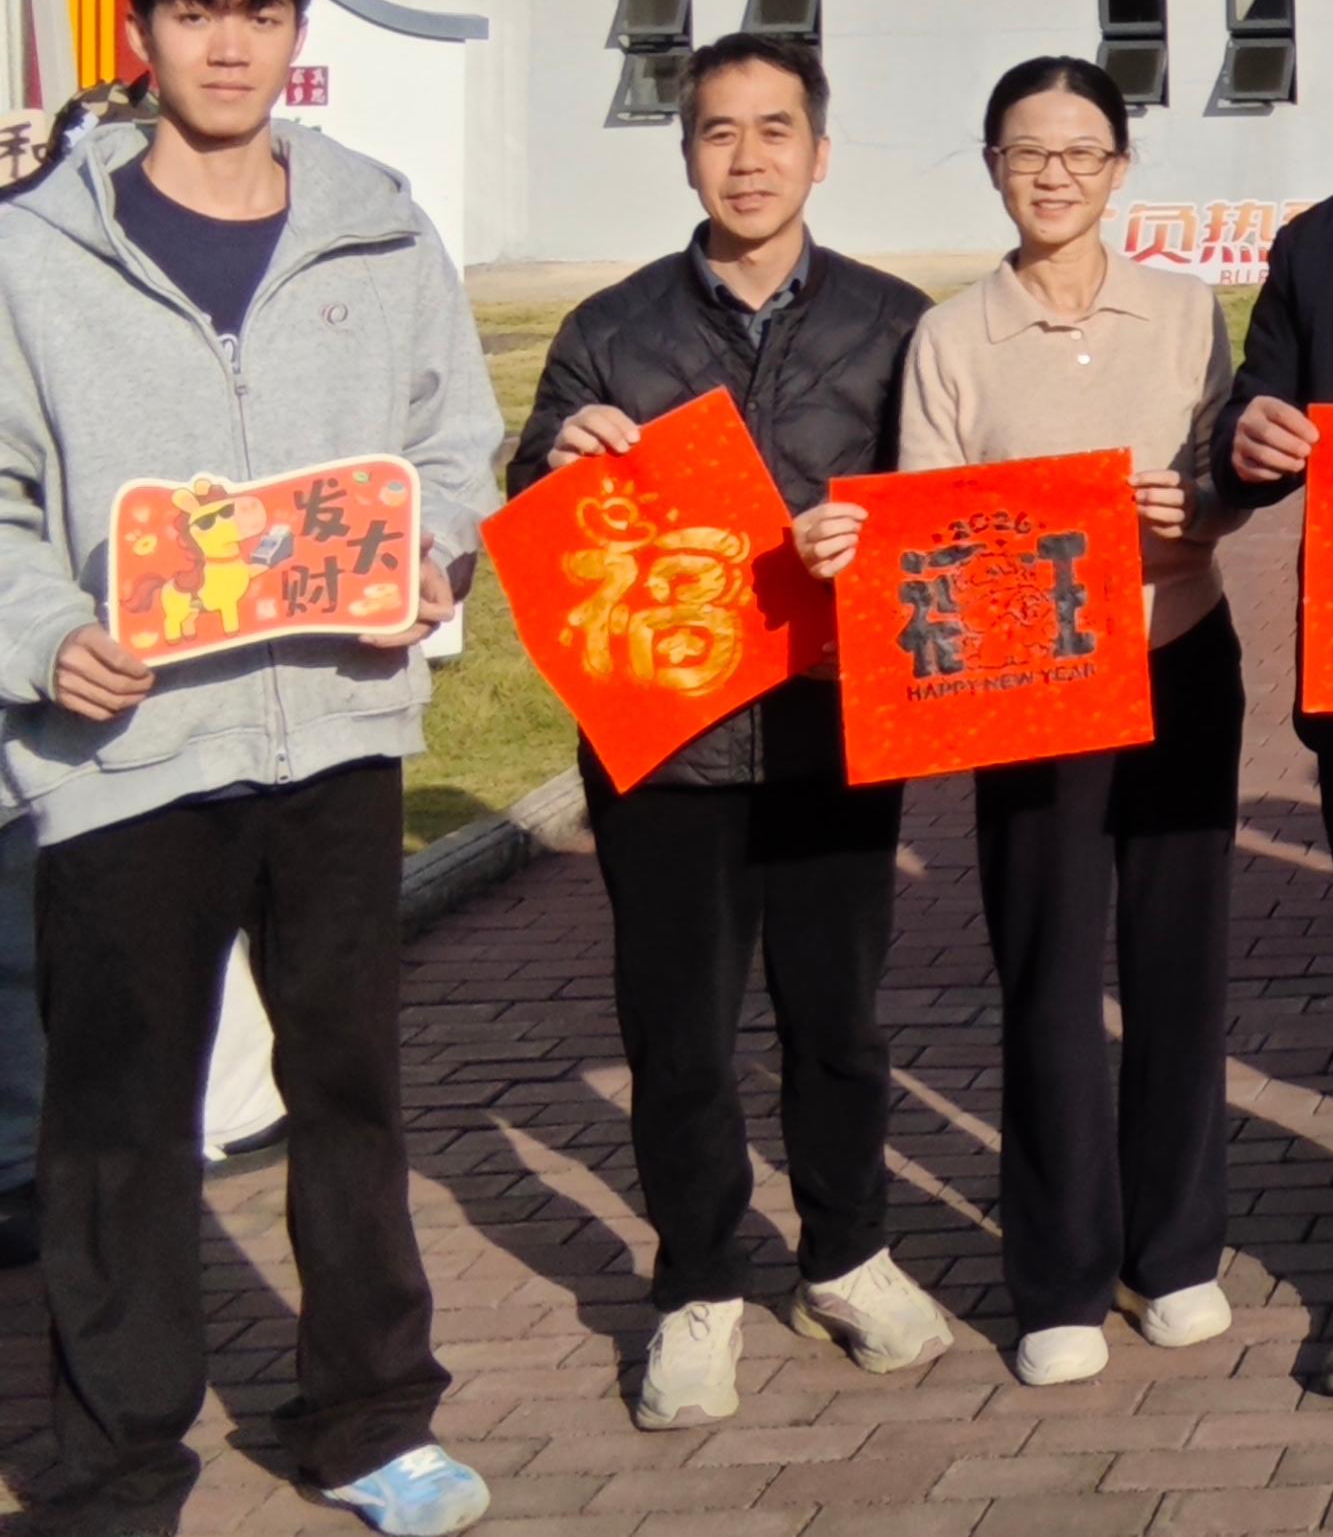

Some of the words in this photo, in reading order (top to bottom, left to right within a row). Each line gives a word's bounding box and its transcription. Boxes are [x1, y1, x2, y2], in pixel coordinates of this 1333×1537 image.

[1102, 201, 1300, 264] 负热
[281, 478, 404, 618] 发大财
[560, 494, 752, 698] 福
[907, 677, 980, 702] HAPPY
[982, 670, 1033, 692] NEW
